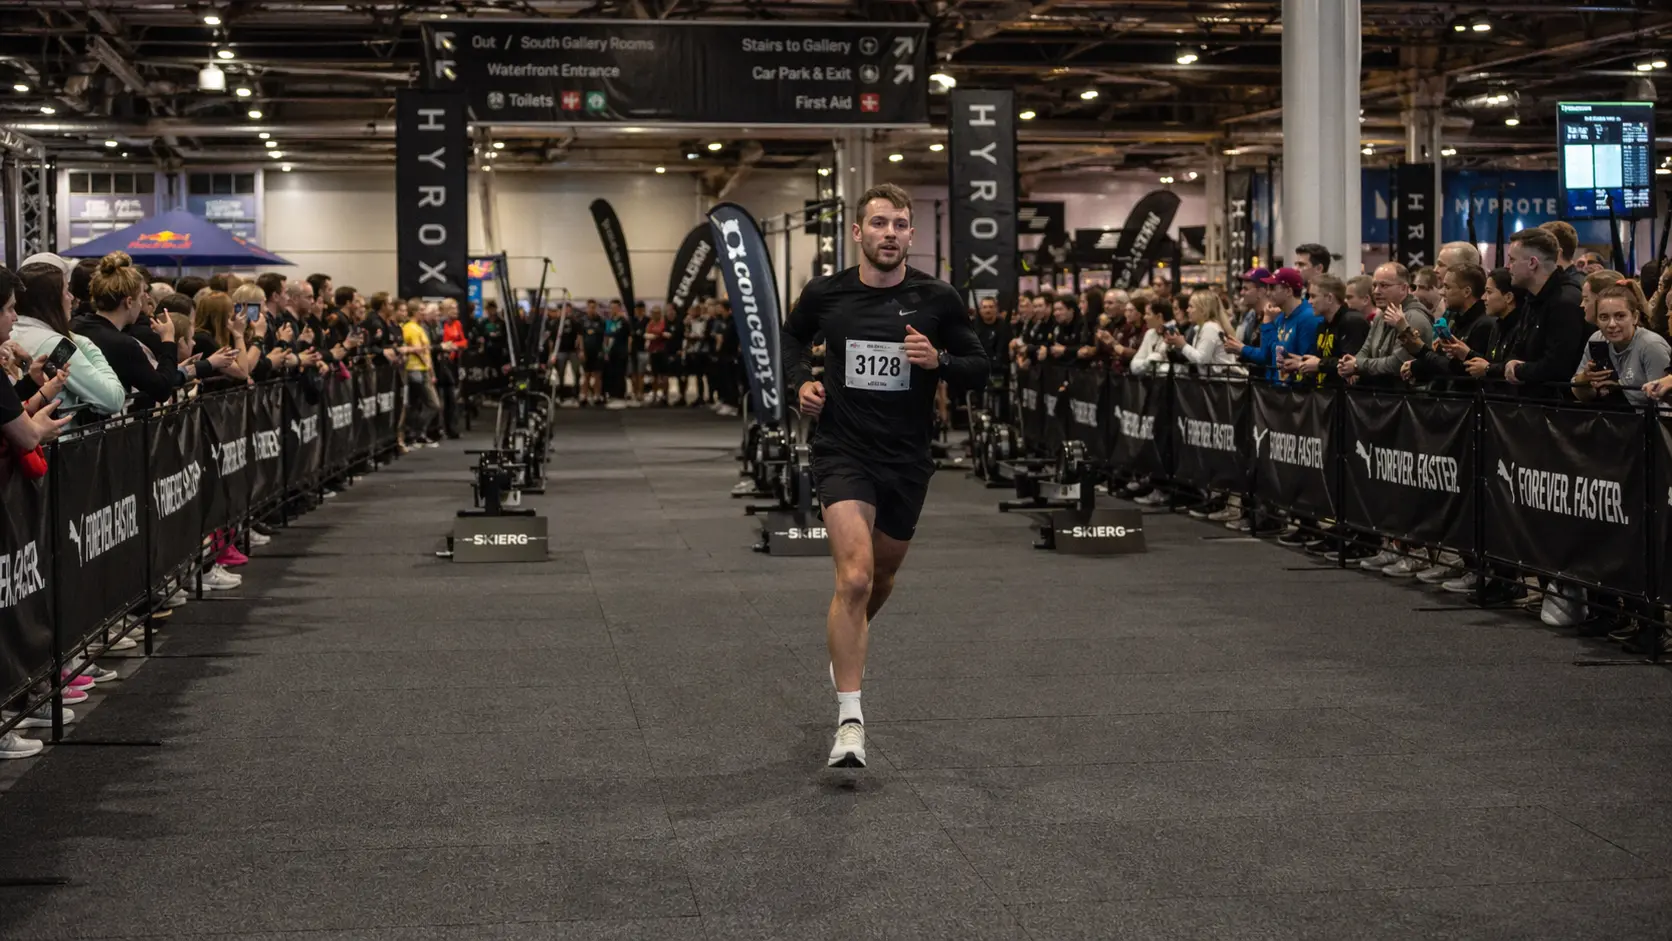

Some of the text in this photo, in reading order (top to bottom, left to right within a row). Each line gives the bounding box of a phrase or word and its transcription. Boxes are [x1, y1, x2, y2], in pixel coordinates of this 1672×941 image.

[471, 34, 654, 52] Out / South Gallery Rooms
[741, 38, 852, 55] Stairs to Gallery
[487, 62, 620, 77] Waterfront Entrance
[751, 66, 852, 80] Car Park & Exit
[508, 93, 553, 107] Toilets
[795, 95, 852, 109] First Aid
[416, 108, 447, 284] HYROX
[969, 104, 999, 276] HYROX
[1455, 198, 1557, 215] MYPROTE
[855, 354, 900, 377] 3128
[1374, 446, 1460, 493] FOREVER. FASTER.
[1517, 466, 1629, 525] FOREVER. FASTER.
[473, 534, 528, 545] SKIERG
[1072, 526, 1126, 538] SKIERG
